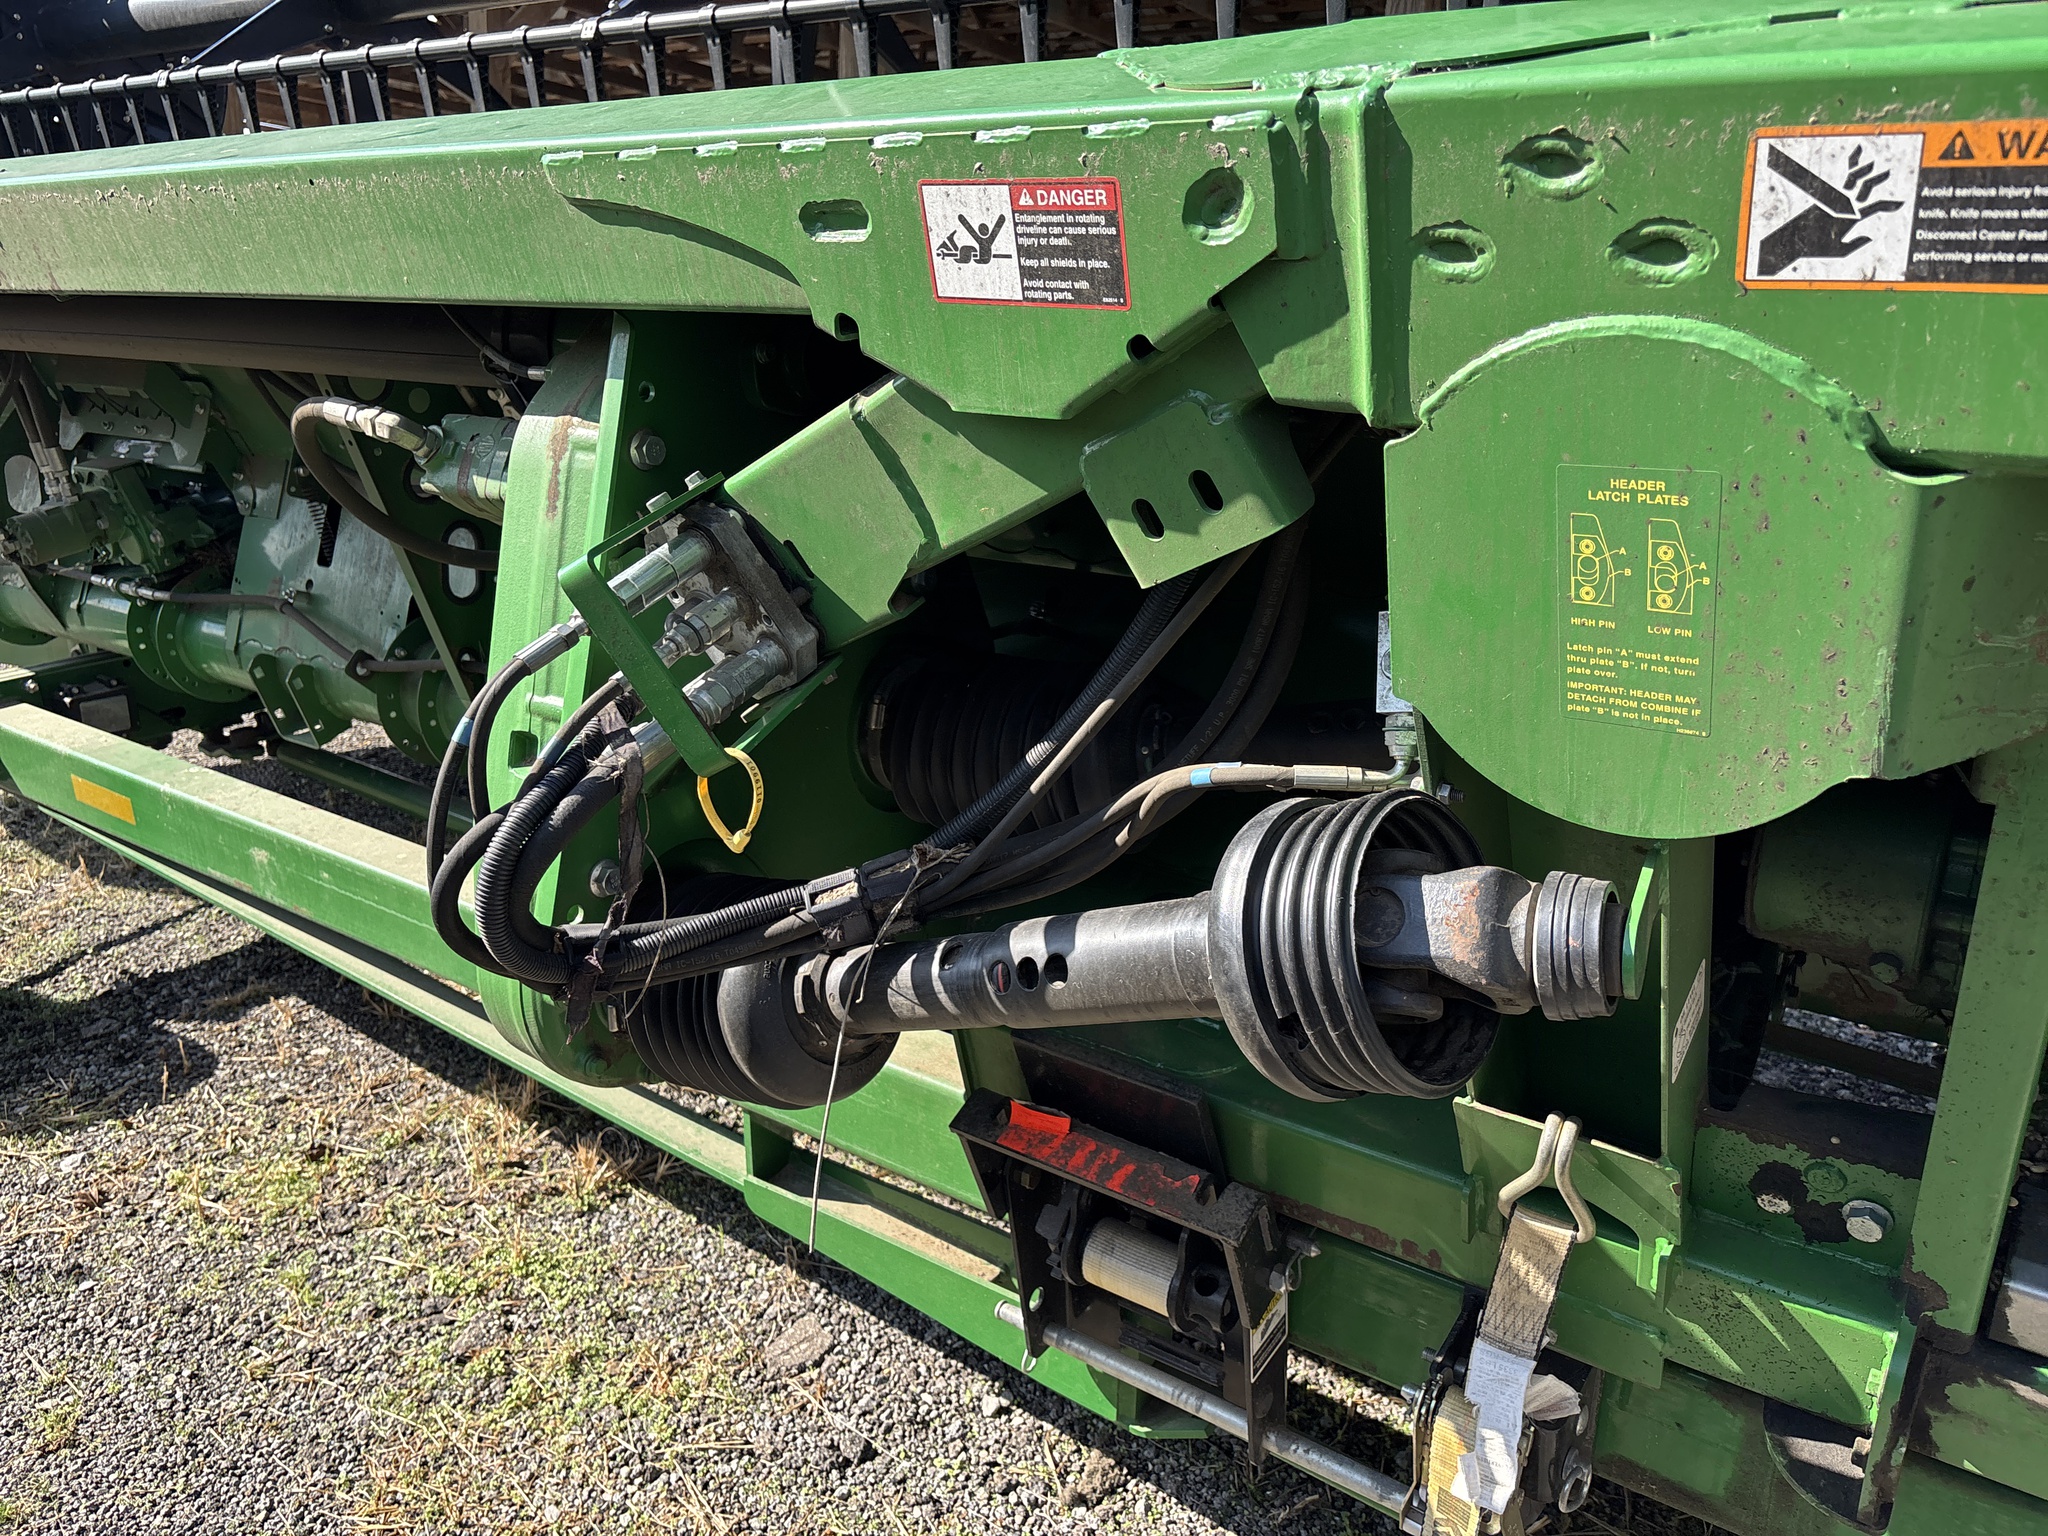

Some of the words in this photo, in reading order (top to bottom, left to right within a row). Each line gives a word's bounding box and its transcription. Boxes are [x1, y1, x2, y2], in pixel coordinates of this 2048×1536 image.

[1036, 189, 1107, 206] DANGER
[1921, 186, 1954, 198] Avoid
[1954, 186, 1998, 198] serious
[1998, 185, 2032, 199] injury
[1014, 213, 1066, 225] Entanglement
[1066, 213, 1074, 223] in
[1075, 213, 1105, 225] rotating
[1918, 207, 1949, 219] knife.
[1950, 207, 1980, 219] Knife
[1981, 209, 2020, 219] moves
[1016, 225, 1047, 234] driveline
[1048, 226, 1062, 234] can
[1064, 227, 1086, 235] cause
[1088, 226, 1116, 235] serious
[1916, 229, 1977, 240] Disconnect
[1979, 229, 2017, 240] Center
[2018, 229, 2048, 240] Feed
[1017, 236, 1038, 247] injury
[1040, 237, 1048, 245] or
[1049, 236, 1072, 246] death.
[1912, 250, 1972, 264] performing
[1974, 251, 2015, 262] service
[2016, 252, 2030, 262] or
[1020, 257, 1039, 268] Keep
[1040, 258, 1049, 267] all
[1050, 258, 1077, 268] shields
[1078, 258, 1086, 268] in
[1088, 258, 1110, 270] place.
[1023, 278, 1044, 288] Avoid
[1045, 280, 1072, 289] contact
[1073, 280, 1089, 289] with
[1024, 290, 1052, 301] rotating
[1054, 292, 1074, 301] parts.
[1610, 478, 1666, 491] HEADER
[1588, 490, 1630, 502] LATCH
[1637, 493, 1689, 506] PLATES
[1619, 547, 1627, 555] A
[1699, 562, 1707, 570] A
[1703, 577, 1710, 585] B
[1571, 617, 1596, 627] HIGH
[1598, 620, 1616, 629] PIN
[1648, 626, 1671, 635] LOW
[1674, 628, 1692, 637] PIN
[1567, 642, 1594, 652] Latch
[1597, 647, 1613, 655] pin
[1635, 651, 1661, 660] must
[1664, 655, 1699, 665] extend
[1567, 654, 1586, 663] thru
[1590, 657, 1615, 666] plate
[1651, 665, 1671, 675] not,
[1674, 666, 1696, 677] turn
[1567, 666, 1591, 675] plate
[1594, 670, 1618, 679] over.
[1567, 681, 1627, 696] IMPORTANT:
[1630, 689, 1672, 702] HEADER
[1675, 694, 1697, 705] MAY
[1567, 692, 1606, 704] DETACH
[1609, 698, 1638, 708] FROM
[1640, 701, 1688, 716] COMBINE
[1691, 708, 1701, 716] IF
[1567, 704, 1590, 713] plate
[1611, 709, 1620, 717] is
[1622, 711, 1638, 719] not
[1641, 713, 1650, 721] in
[1654, 716, 1683, 726] place.
